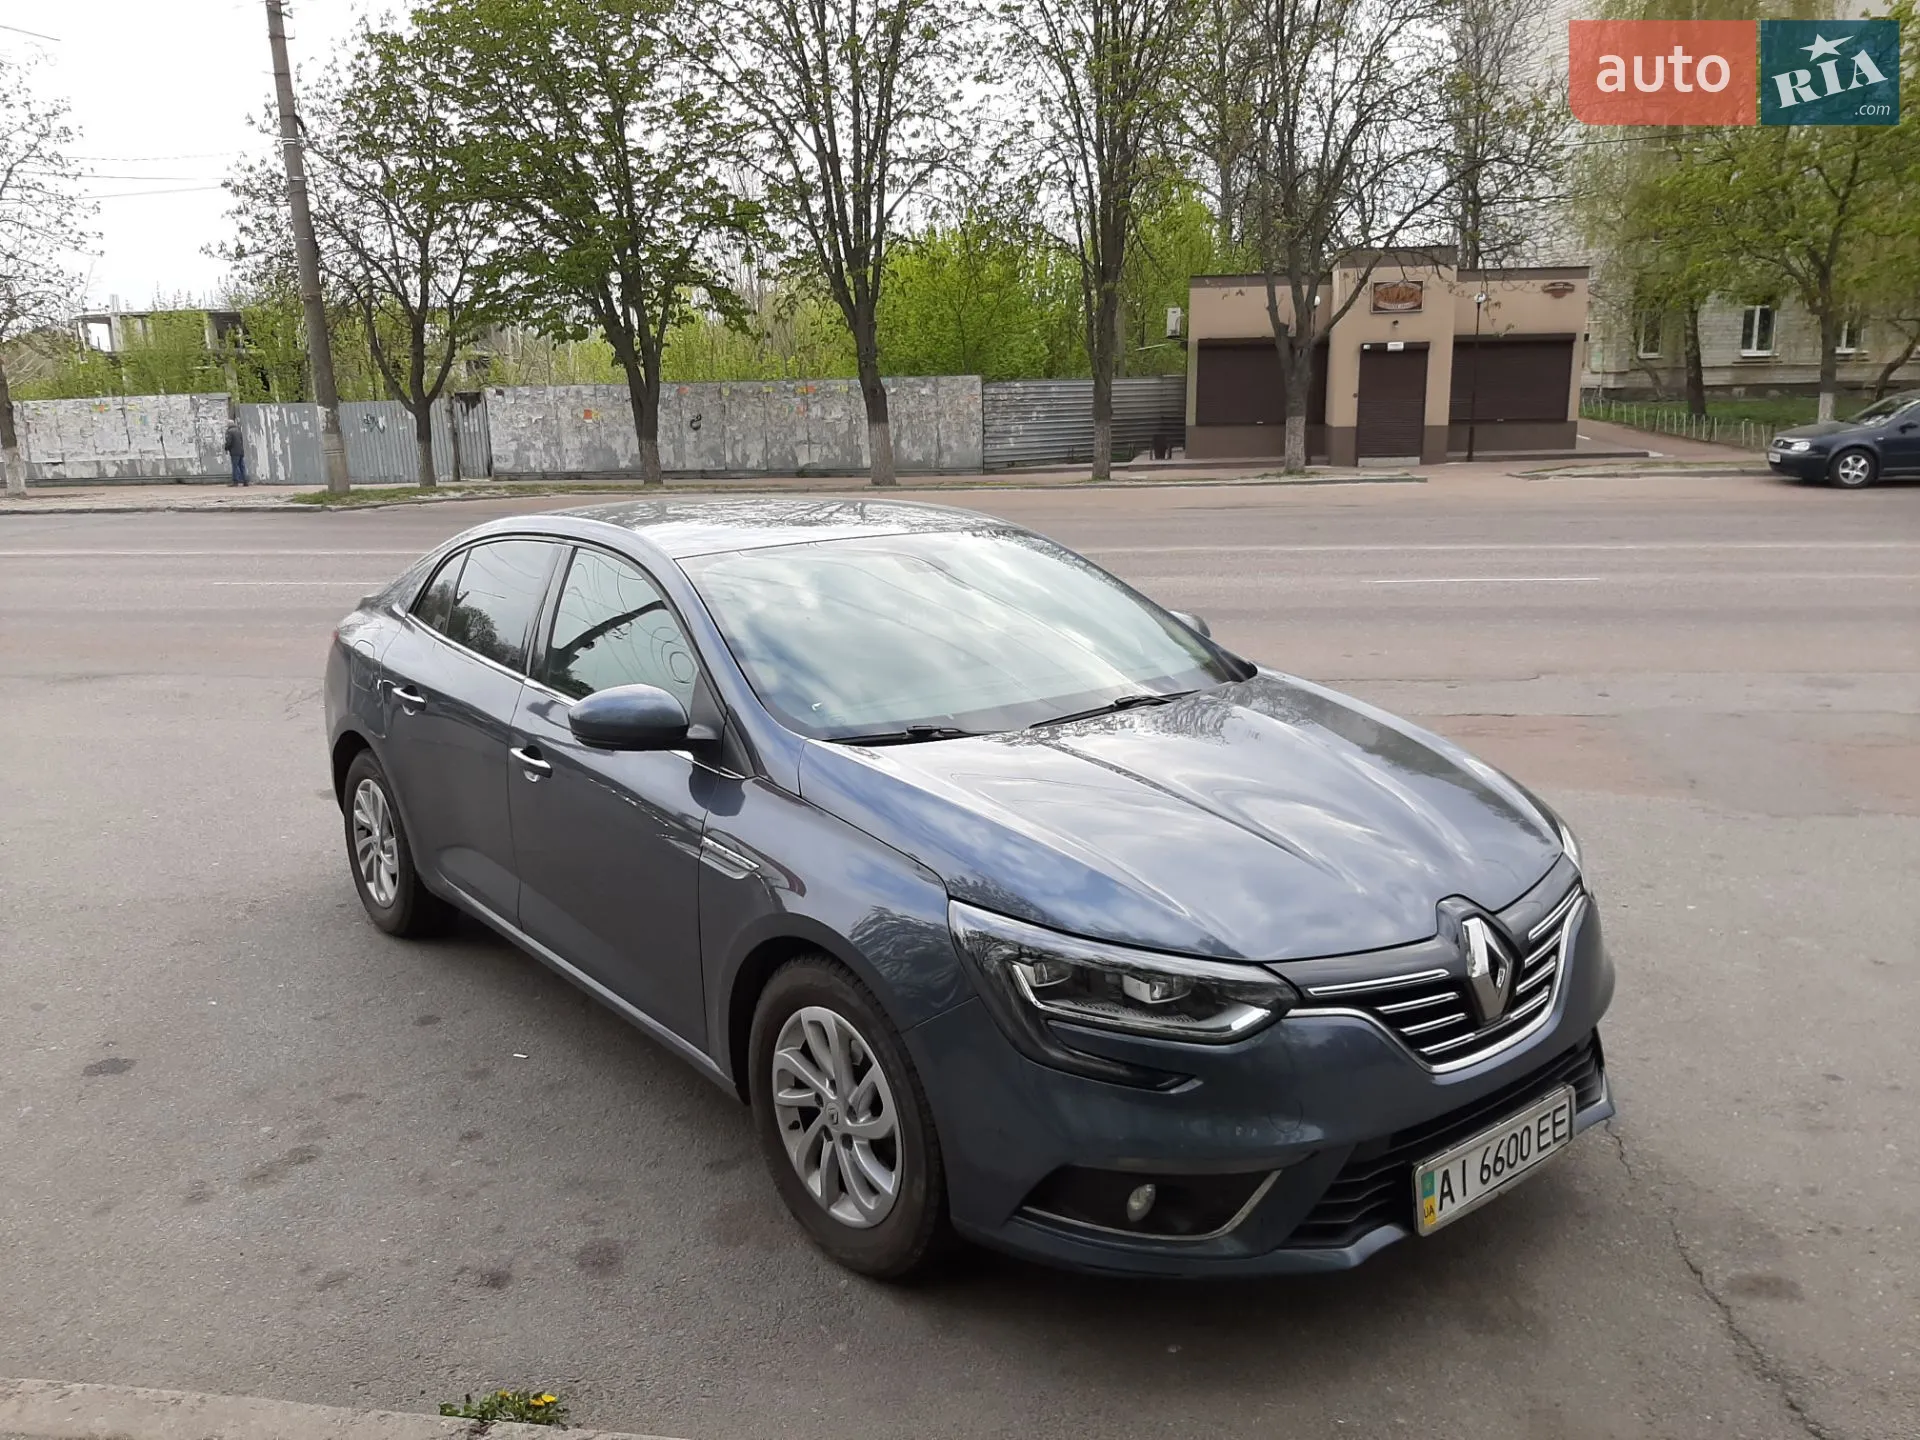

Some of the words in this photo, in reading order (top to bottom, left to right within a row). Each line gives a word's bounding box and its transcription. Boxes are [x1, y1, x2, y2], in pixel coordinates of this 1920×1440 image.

[1439, 1160, 1466, 1211] AI
[1480, 1126, 1531, 1184] 6600
[1538, 1104, 1566, 1152] EE
